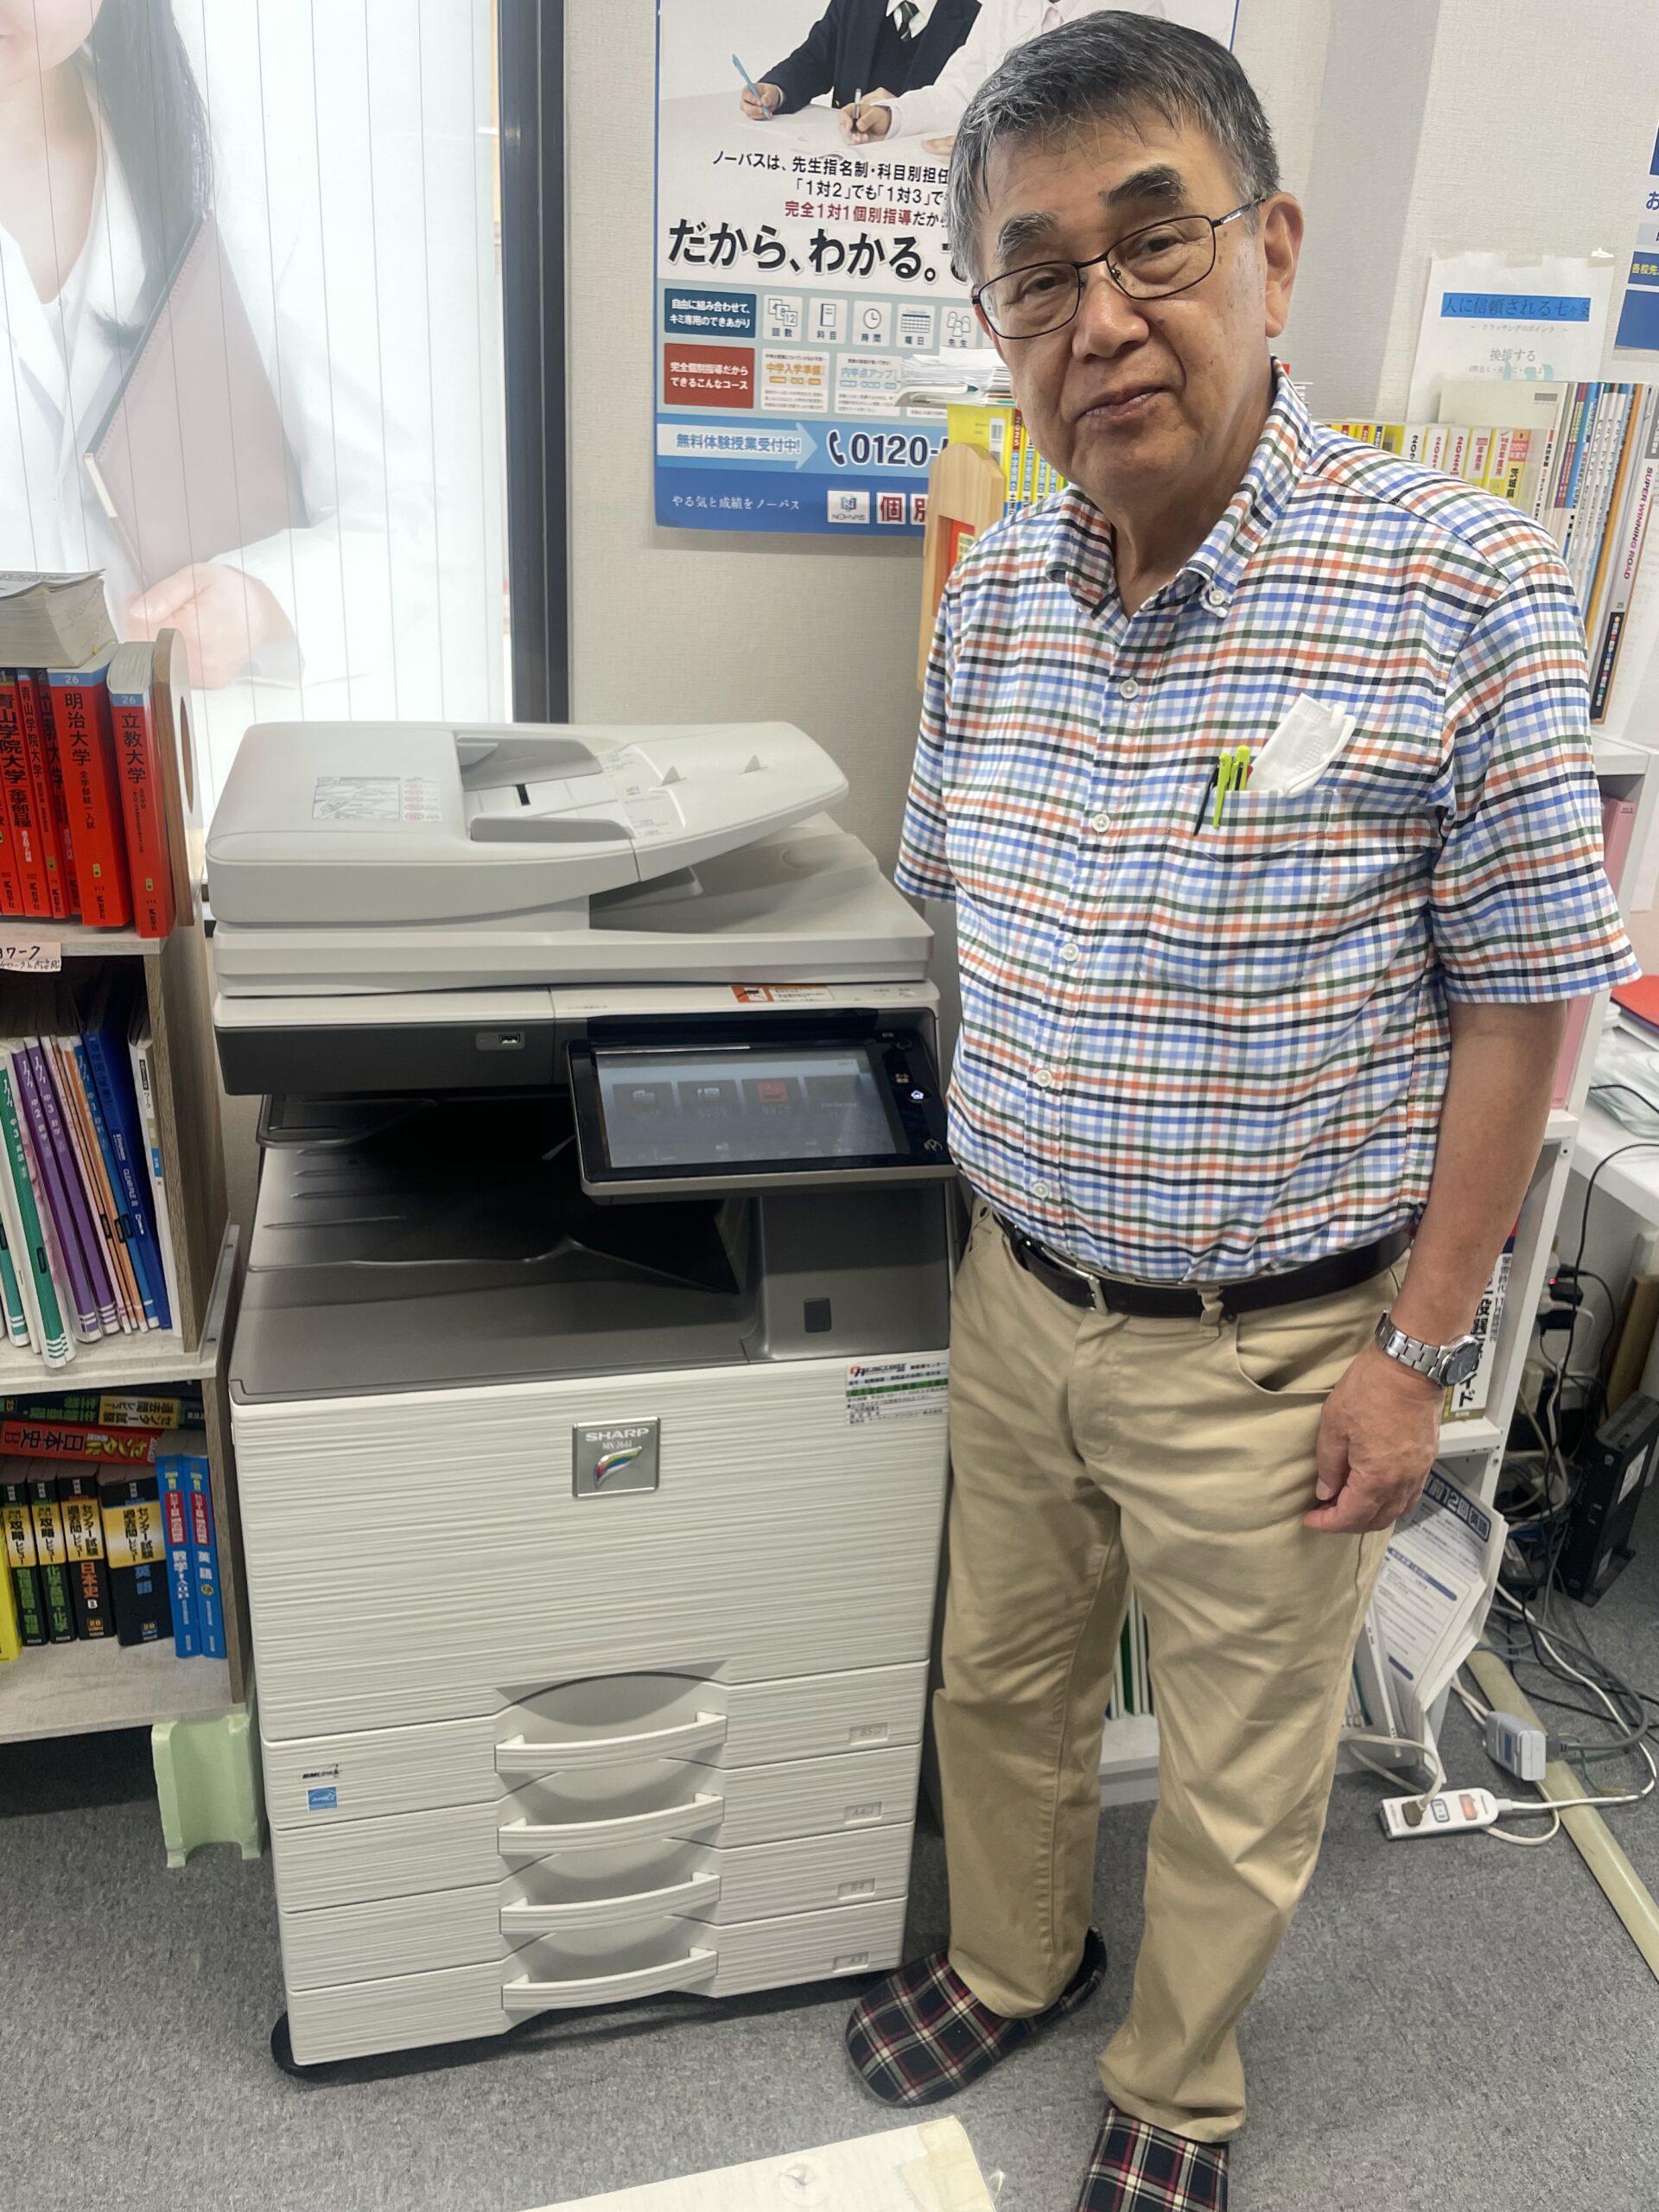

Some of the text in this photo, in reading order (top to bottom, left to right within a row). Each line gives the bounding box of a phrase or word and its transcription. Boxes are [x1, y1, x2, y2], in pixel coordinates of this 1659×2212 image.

[796, 177, 948, 206] 「1対2」でも「1対3」で
[668, 218, 967, 285] だから、わかる。
[677, 433, 801, 454] 無料体験授業受付中!
[850, 432, 948, 467] 0120-
[1623, 467, 1653, 580] SUPER WINNING ROAD
[65, 675, 79, 684] 26
[122, 695, 137, 705] 26
[65, 693, 92, 766] 明治大学
[122, 713, 147, 785] 立教大学
[585, 1427, 650, 1442] SHARP
